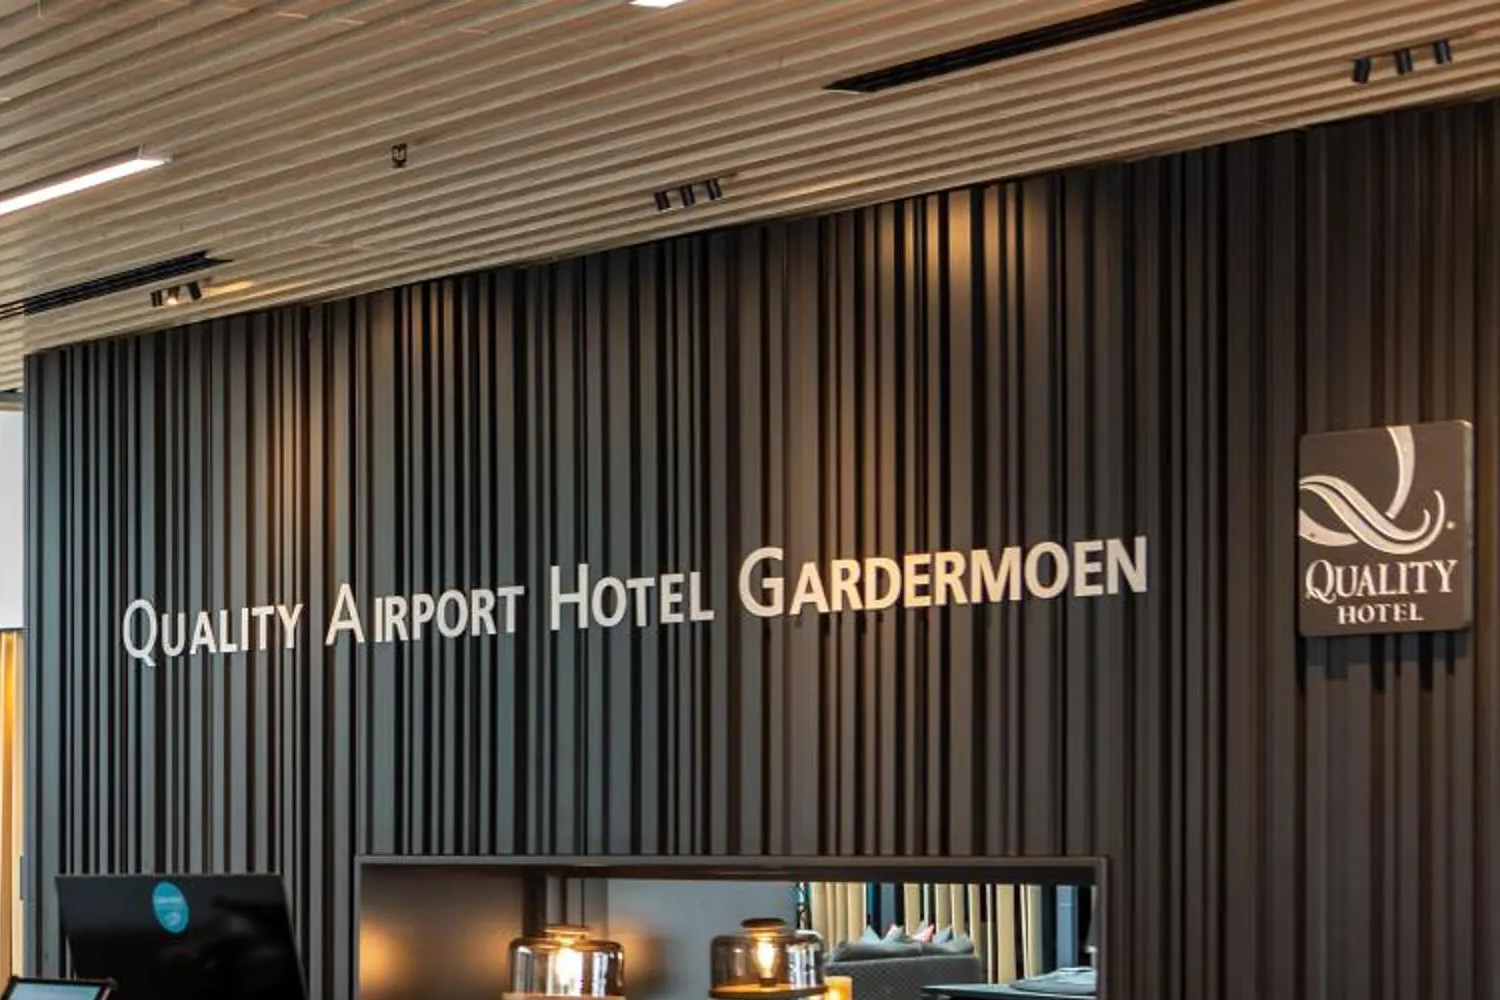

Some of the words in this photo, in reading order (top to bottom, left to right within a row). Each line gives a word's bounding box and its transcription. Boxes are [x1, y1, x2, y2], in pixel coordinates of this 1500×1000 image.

[122, 598, 304, 667] QUALITY
[325, 583, 525, 646] AIRPORT
[550, 563, 715, 631] HOTEL
[738, 535, 1148, 617] GARDERMOEN
[1305, 559, 1458, 604] QUALITY
[1337, 602, 1424, 625] HOTEL
